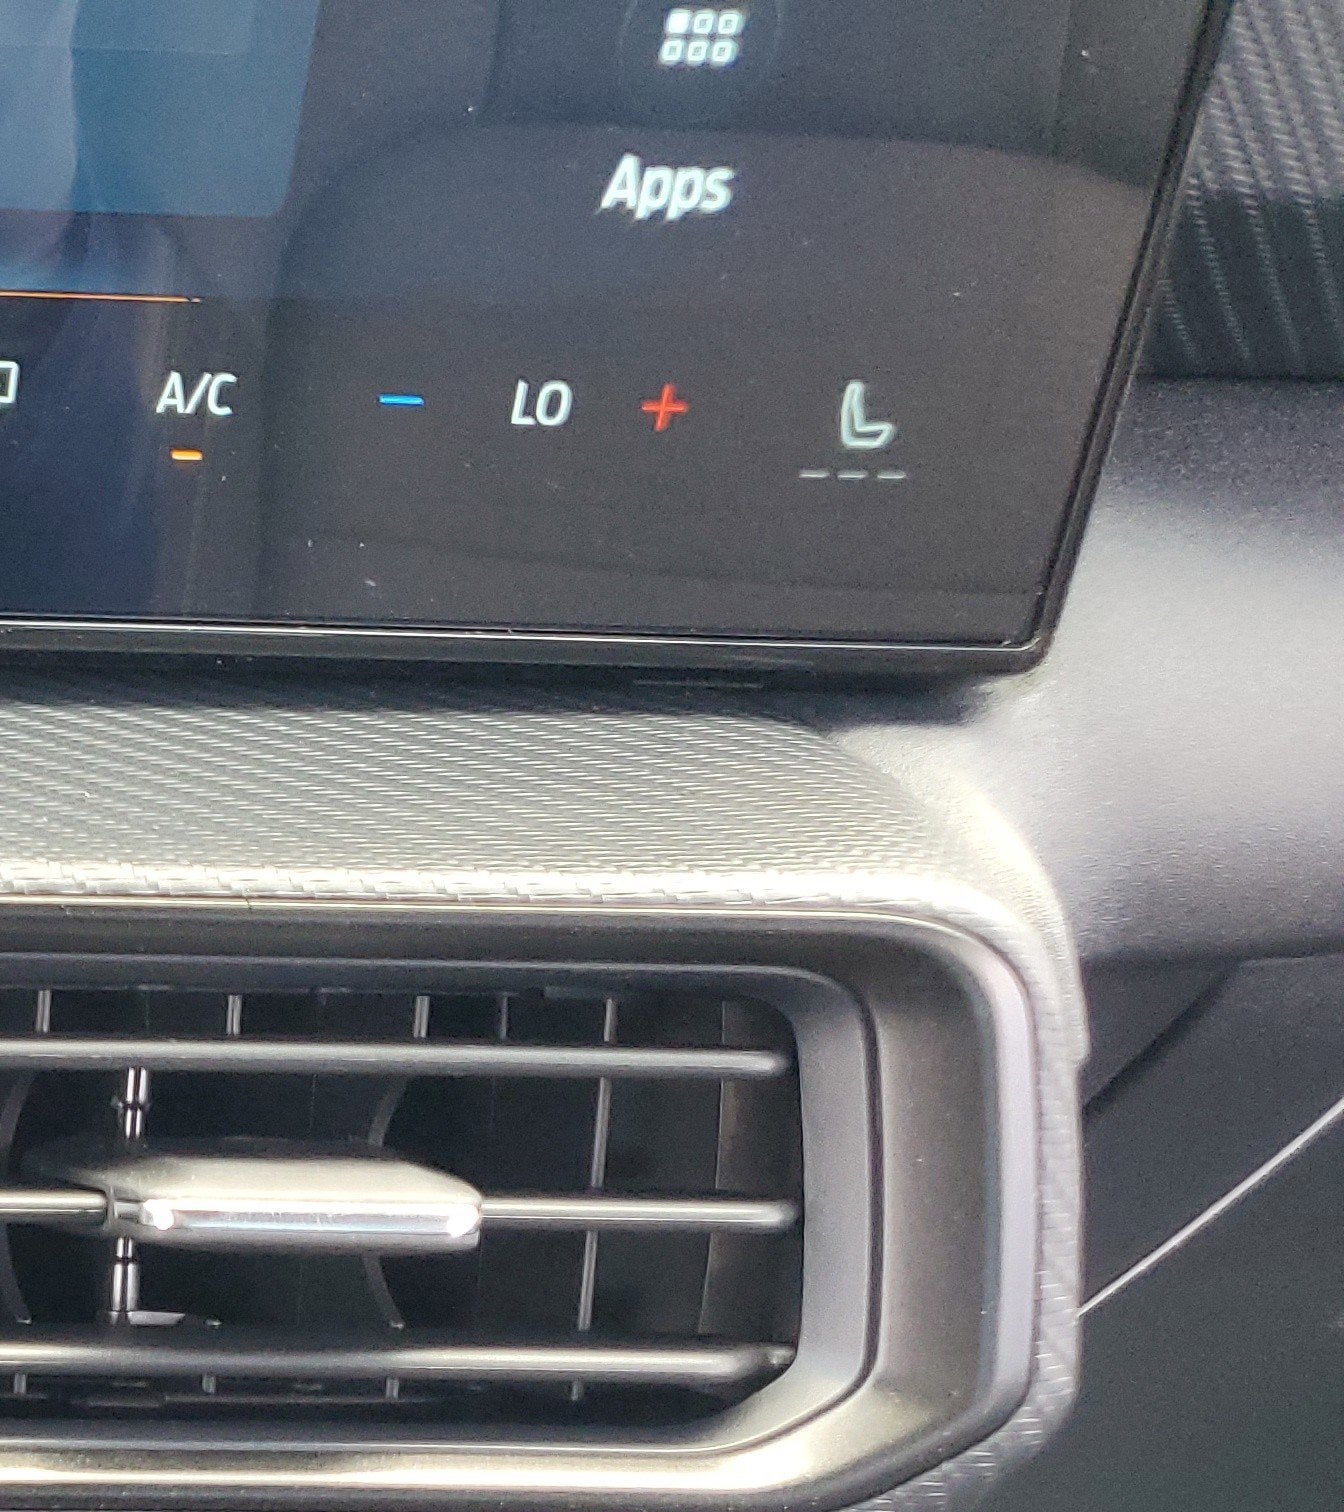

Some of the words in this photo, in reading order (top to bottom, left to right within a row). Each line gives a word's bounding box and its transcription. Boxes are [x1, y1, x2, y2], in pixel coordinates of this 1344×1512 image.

[600, 153, 735, 220] Apps
[156, 371, 238, 416] A/C
[510, 380, 573, 426] LO
